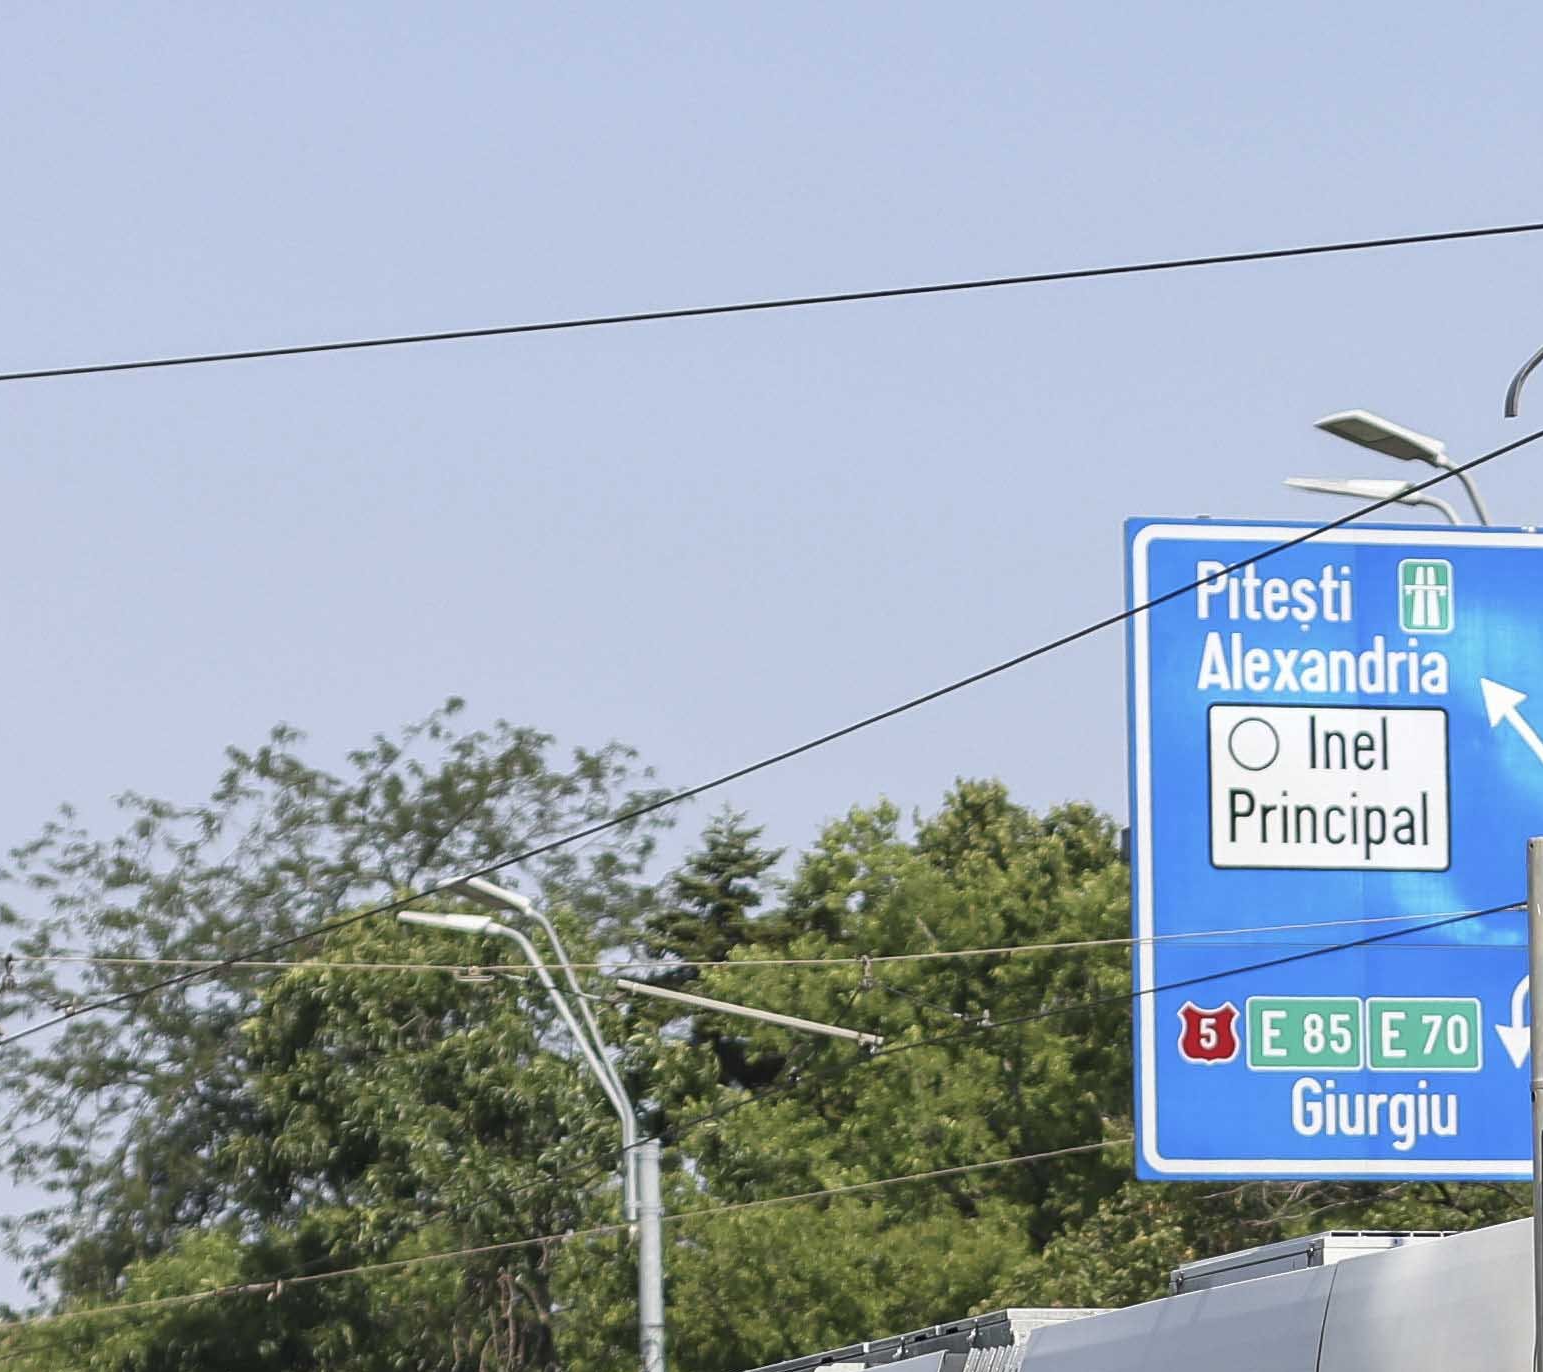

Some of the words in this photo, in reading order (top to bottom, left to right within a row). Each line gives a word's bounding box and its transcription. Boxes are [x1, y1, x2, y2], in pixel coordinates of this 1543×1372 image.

[1196, 560, 1351, 631] Pitești
[1197, 632, 1449, 695] Alexandria
[1308, 714, 1389, 771] Inel
[1228, 789, 1430, 861] Principal
[1198, 1016, 1218, 1051] 5
[1262, 1015, 1288, 1058] E
[1302, 1012, 1353, 1056] 85
[1381, 1012, 1408, 1058] E
[1421, 1012, 1470, 1056] 70
[1291, 1077, 1458, 1152] Giurgiu
